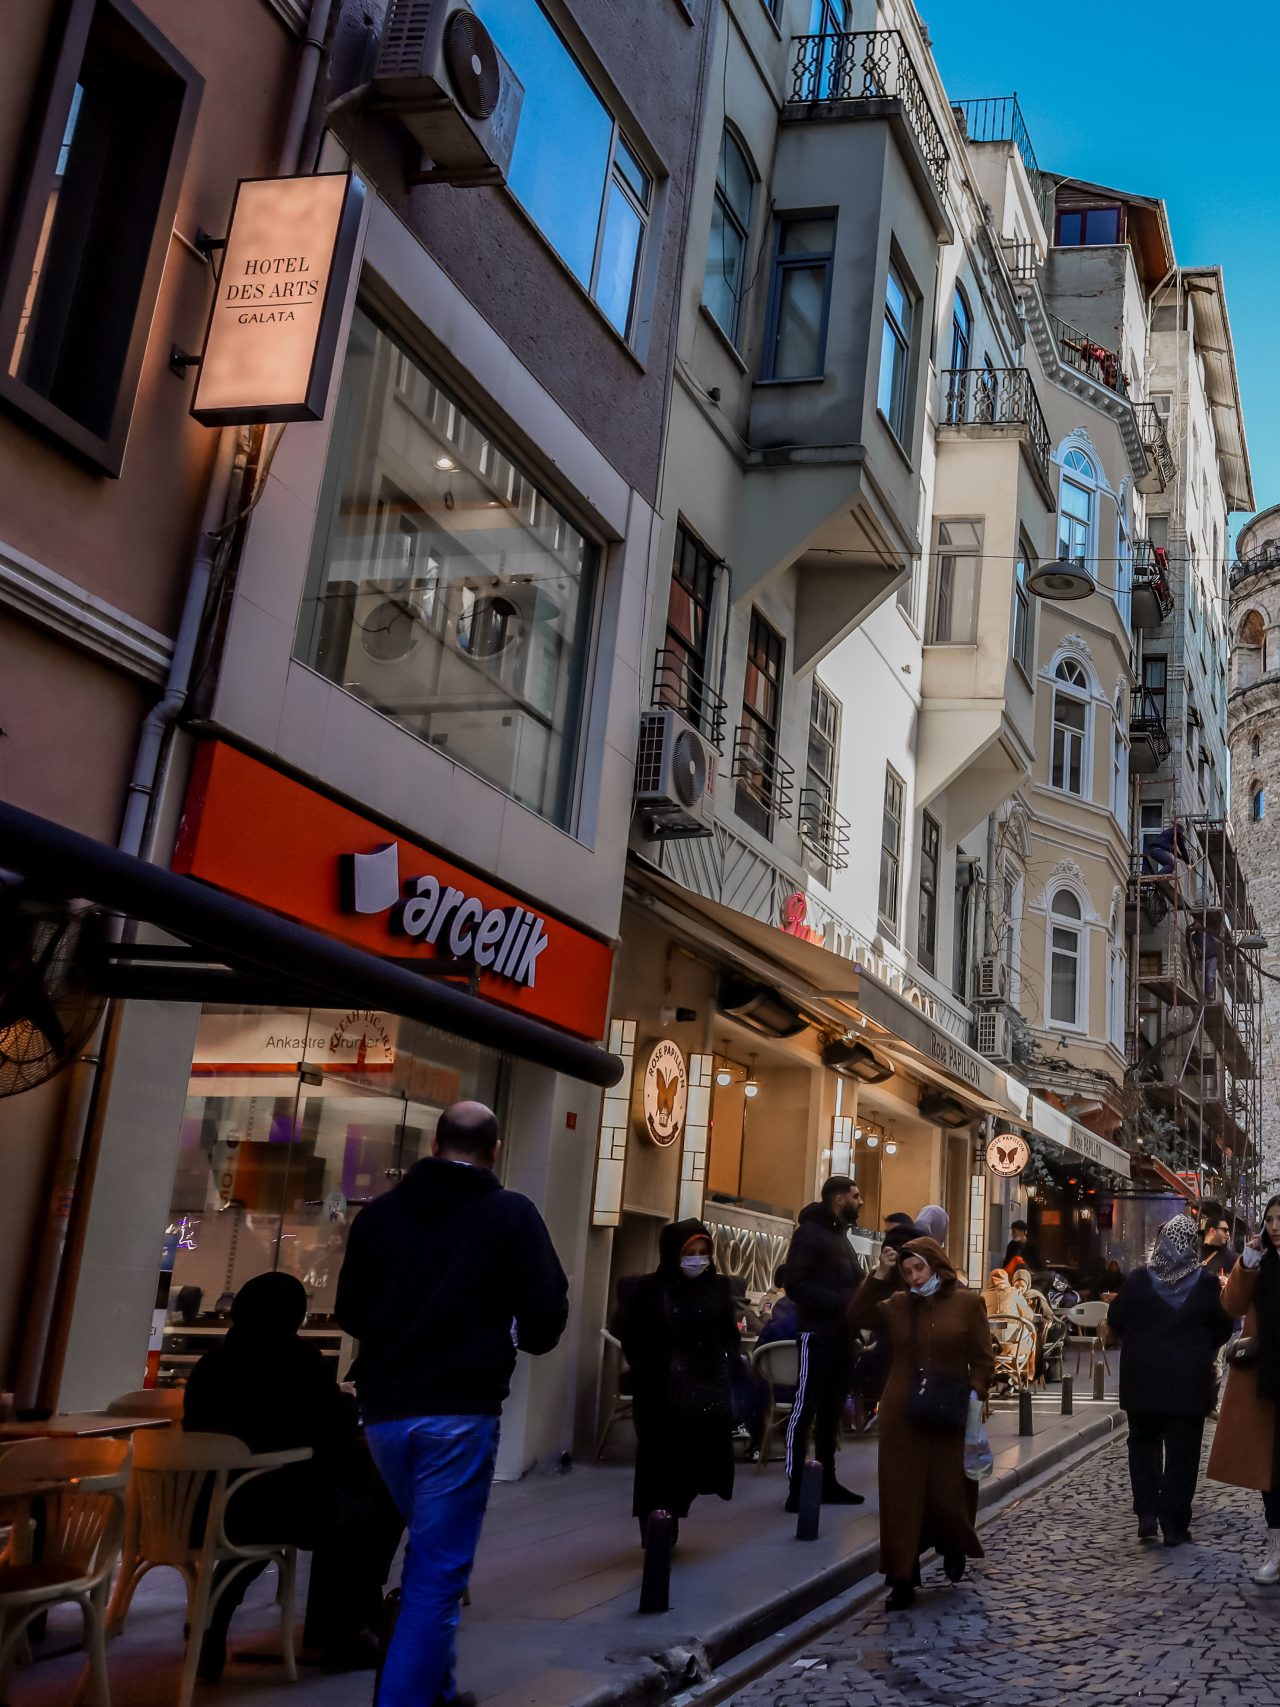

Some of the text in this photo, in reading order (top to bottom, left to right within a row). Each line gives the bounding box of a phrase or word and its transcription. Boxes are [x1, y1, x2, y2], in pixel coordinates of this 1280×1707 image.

[243, 257, 310, 275] HOTEL
[225, 280, 319, 300] DES ARTS
[238, 311, 295, 324] GALATA
[266, 1035, 325, 1049] Ankastre
[649, 1045, 685, 1089] ROSE PAPILLON
[931, 1033, 980, 1086] Rose PAPILLON
[990, 1136, 1025, 1152] ROSE PAPILLON
